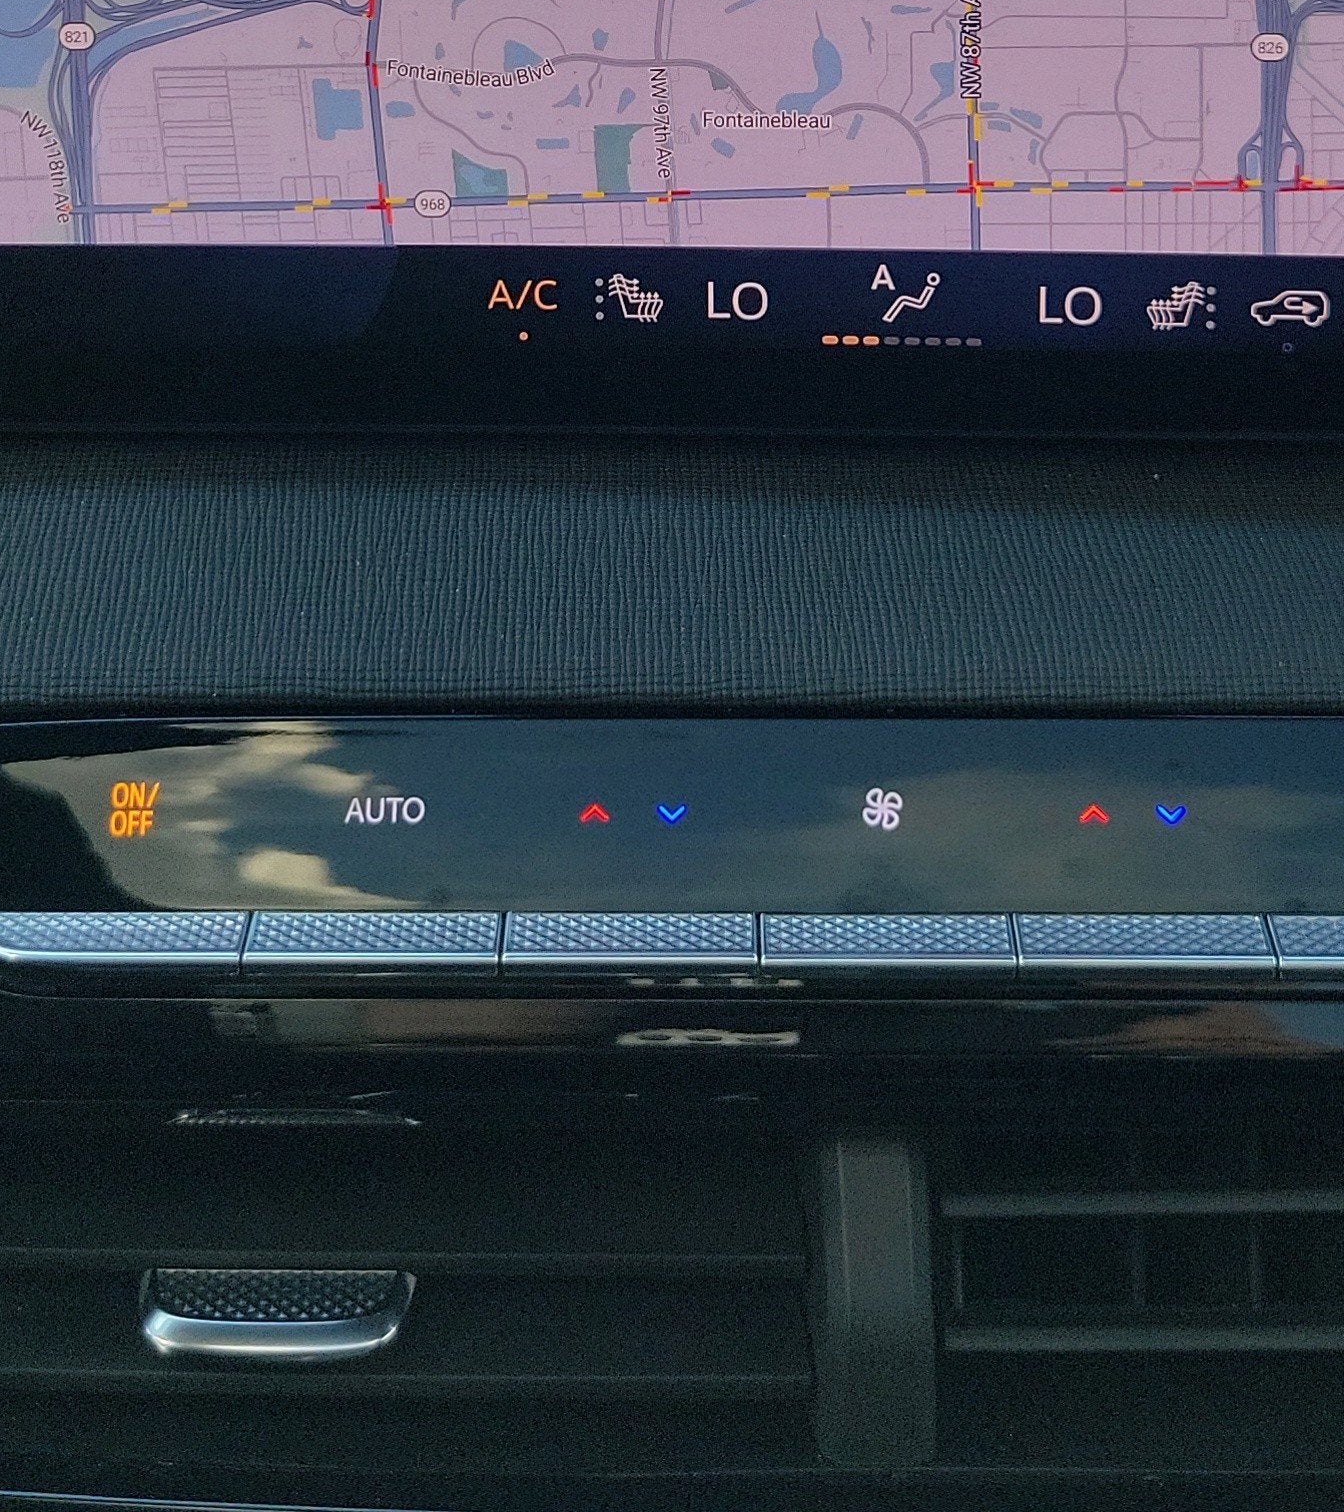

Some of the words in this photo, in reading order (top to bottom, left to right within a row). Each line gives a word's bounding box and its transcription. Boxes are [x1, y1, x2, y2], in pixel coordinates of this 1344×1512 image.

[64, 31, 89, 44] 821
[960, 15, 982, 59] 87th
[1258, 40, 1284, 55] 826
[387, 61, 513, 88] Fontainebleau
[517, 60, 556, 85] Blvd
[650, 68, 668, 101] NW
[960, 62, 982, 99] NW
[651, 103, 670, 143] 97th
[702, 112, 831, 130] Fontainebleau
[20, 111, 50, 143] NW
[41, 135, 67, 189] 118th
[54, 192, 70, 225] Ave
[656, 147, 672, 179] Ave
[420, 198, 446, 211] 968
[870, 264, 895, 291] A
[487, 279, 558, 311] A/C
[707, 280, 769, 320] LO
[1038, 286, 1103, 326] LO
[110, 780, 161, 809] ON/
[109, 810, 154, 837] OFF
[344, 796, 426, 826] AUTO
